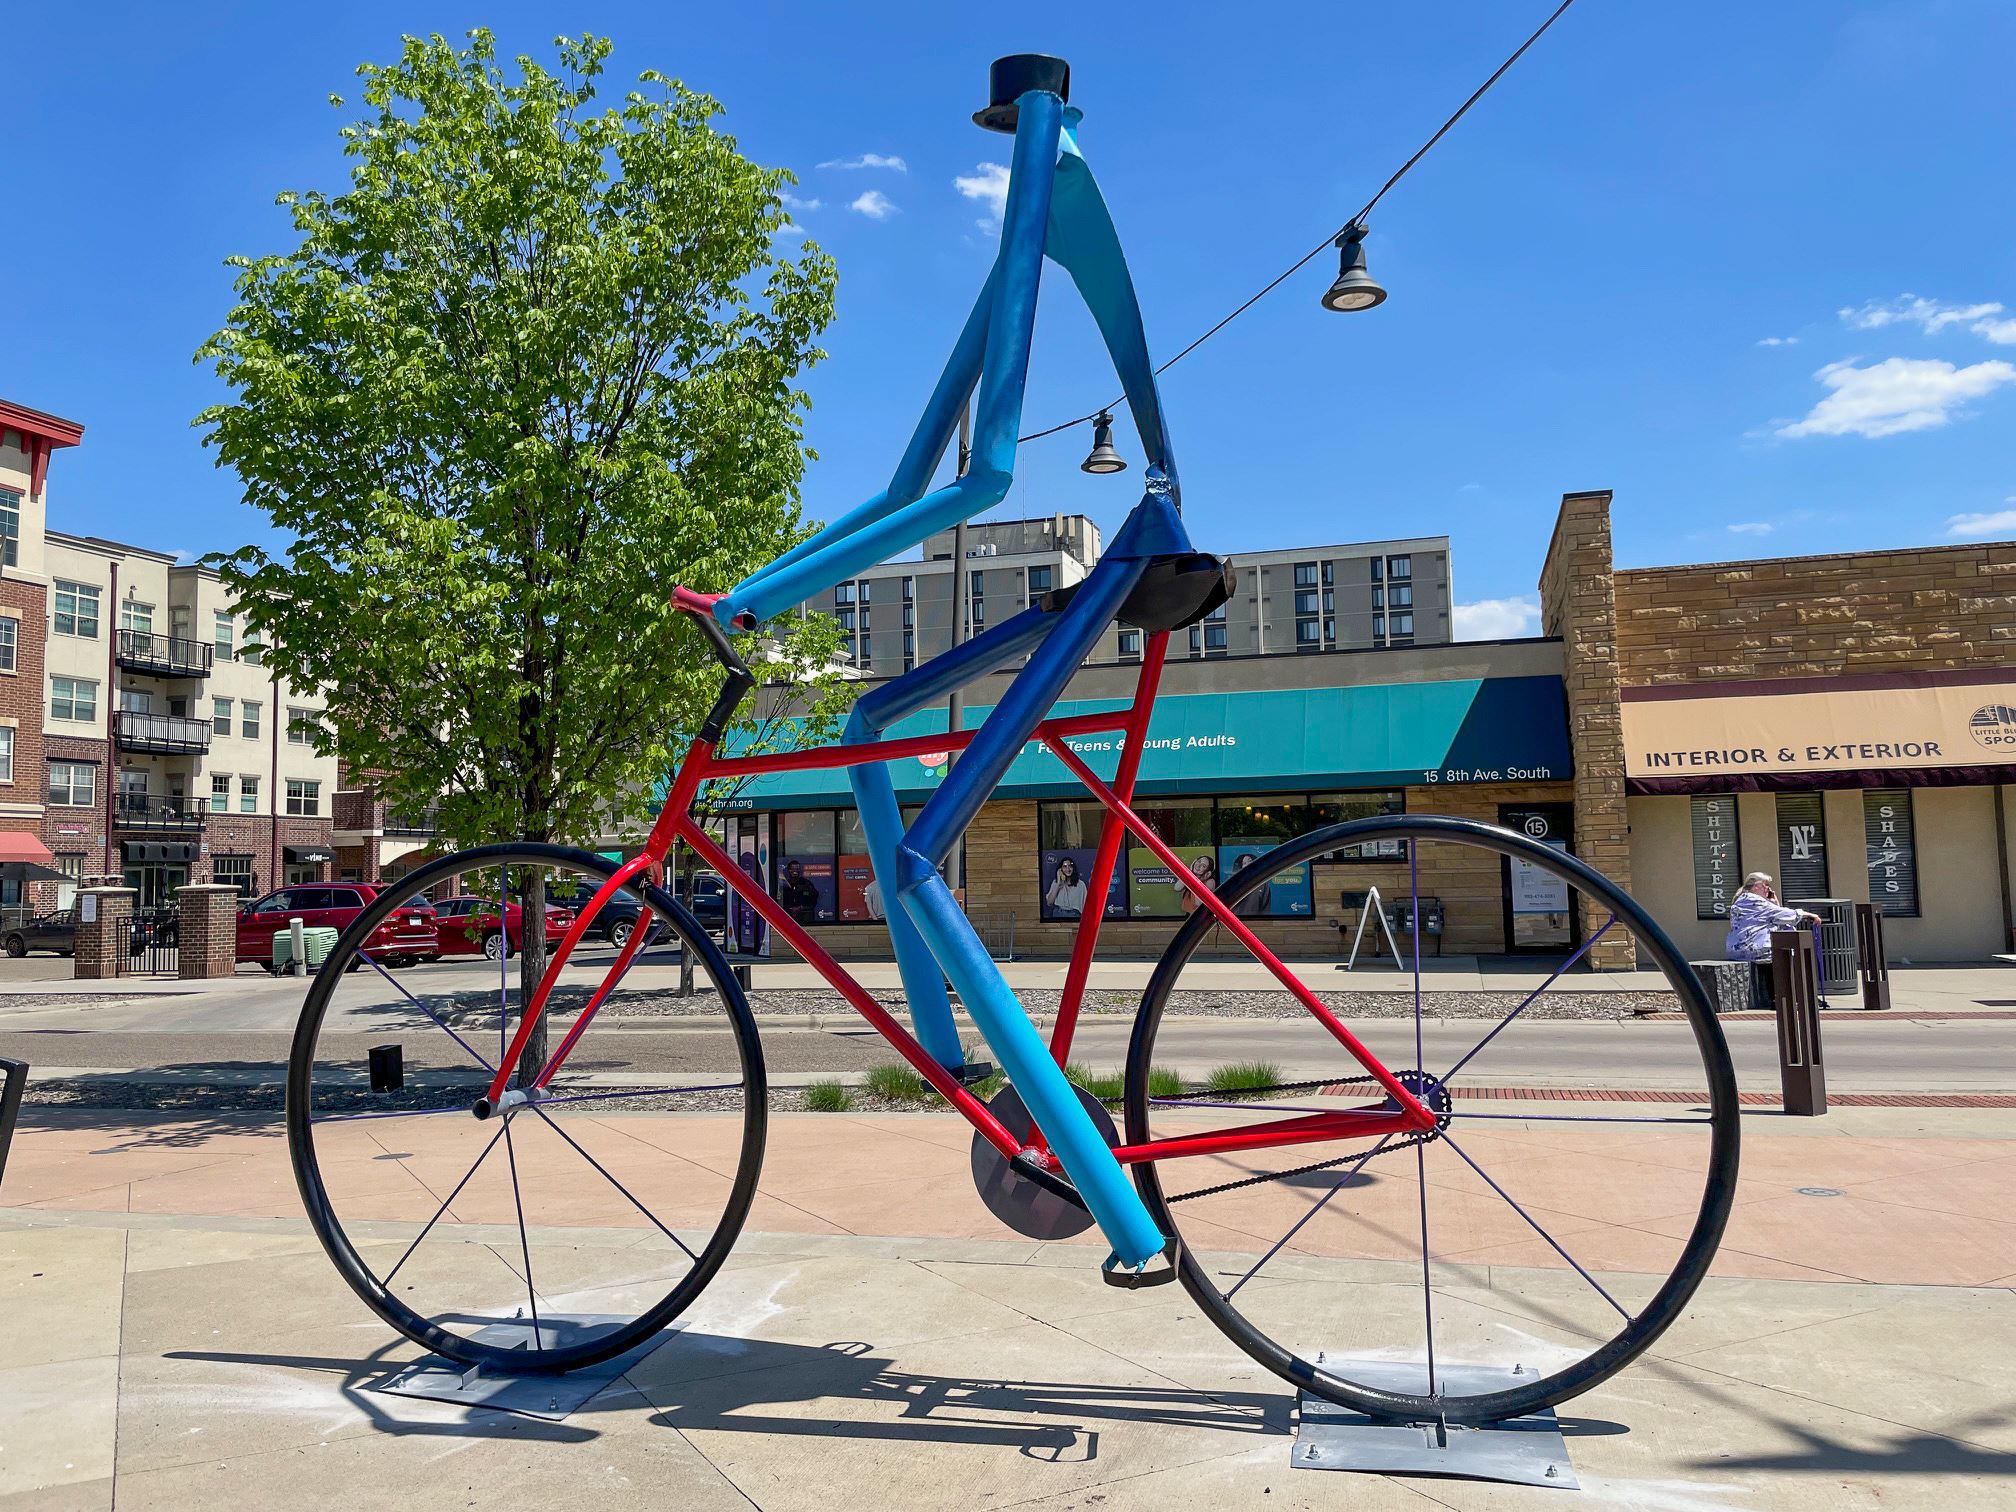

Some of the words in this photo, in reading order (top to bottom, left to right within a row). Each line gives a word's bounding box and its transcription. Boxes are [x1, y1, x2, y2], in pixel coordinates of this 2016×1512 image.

[1066, 740, 1111, 752] Teens
[1143, 737, 1181, 750] oung
[1186, 735, 1236, 748] Adults
[1984, 735, 2016, 745] SPO
[1645, 748, 1768, 767] INTERIOR
[1777, 748, 1796, 762] &
[1806, 741, 1942, 761] EXTERIOR
[1423, 770, 1438, 782] 15
[1446, 769, 1469, 782] 8th
[1473, 768, 1503, 781] Ave.
[1507, 766, 1550, 779] South
[1528, 821, 1544, 834] 15
[1789, 824, 1816, 860] N'
[1879, 806, 1900, 893] SHADES
[1706, 801, 1727, 915] SHUTTERS
